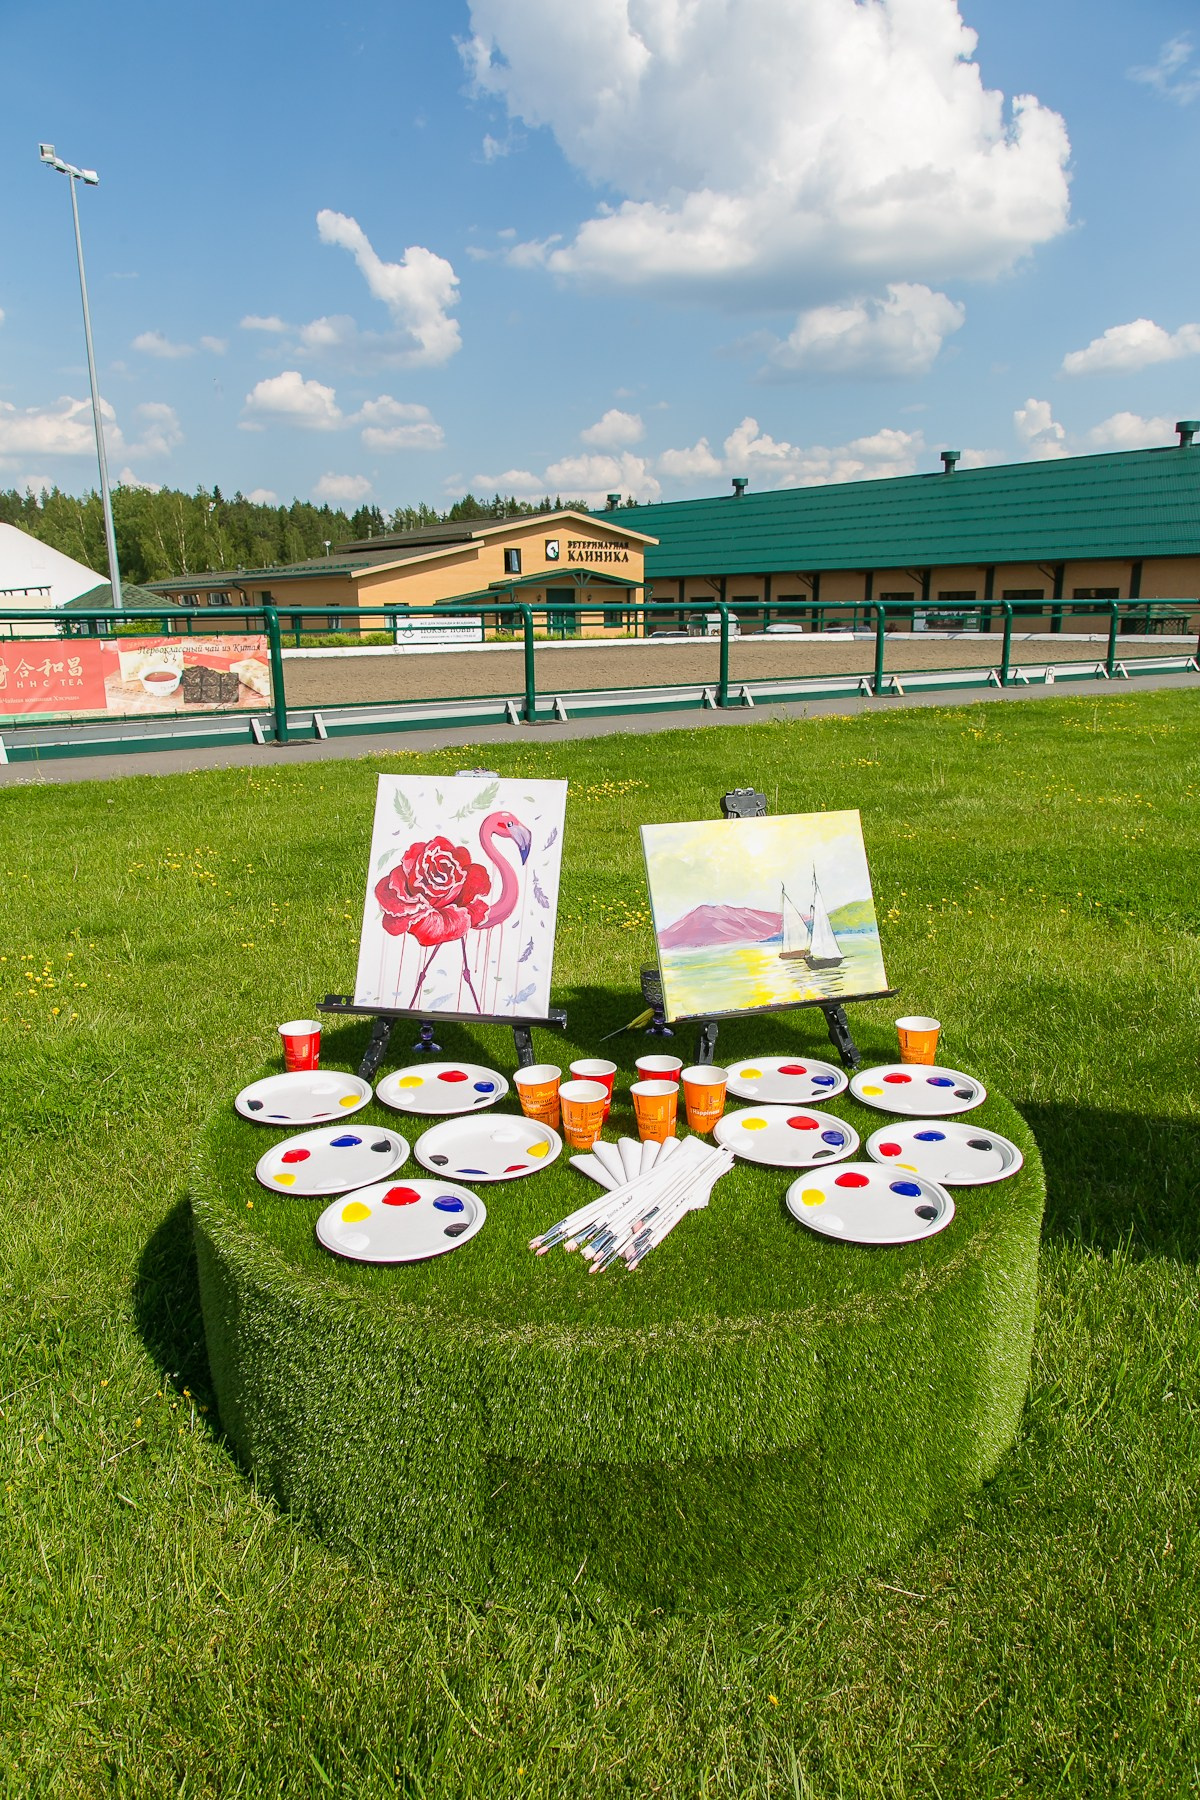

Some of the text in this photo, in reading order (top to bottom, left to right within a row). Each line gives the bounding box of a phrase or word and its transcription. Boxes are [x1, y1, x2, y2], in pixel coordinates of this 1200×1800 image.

[567, 540, 630, 550] ВЕТЕРИНАРНАЯ
[567, 550, 630, 563] КЛИНИКА
[137, 645, 203, 657] Первоклассный
[205, 645, 220, 653] чай
[13, 656, 84, 679] 合和昌
[1046, 667, 1054, 680] R
[60, 679, 84, 687] TEA
